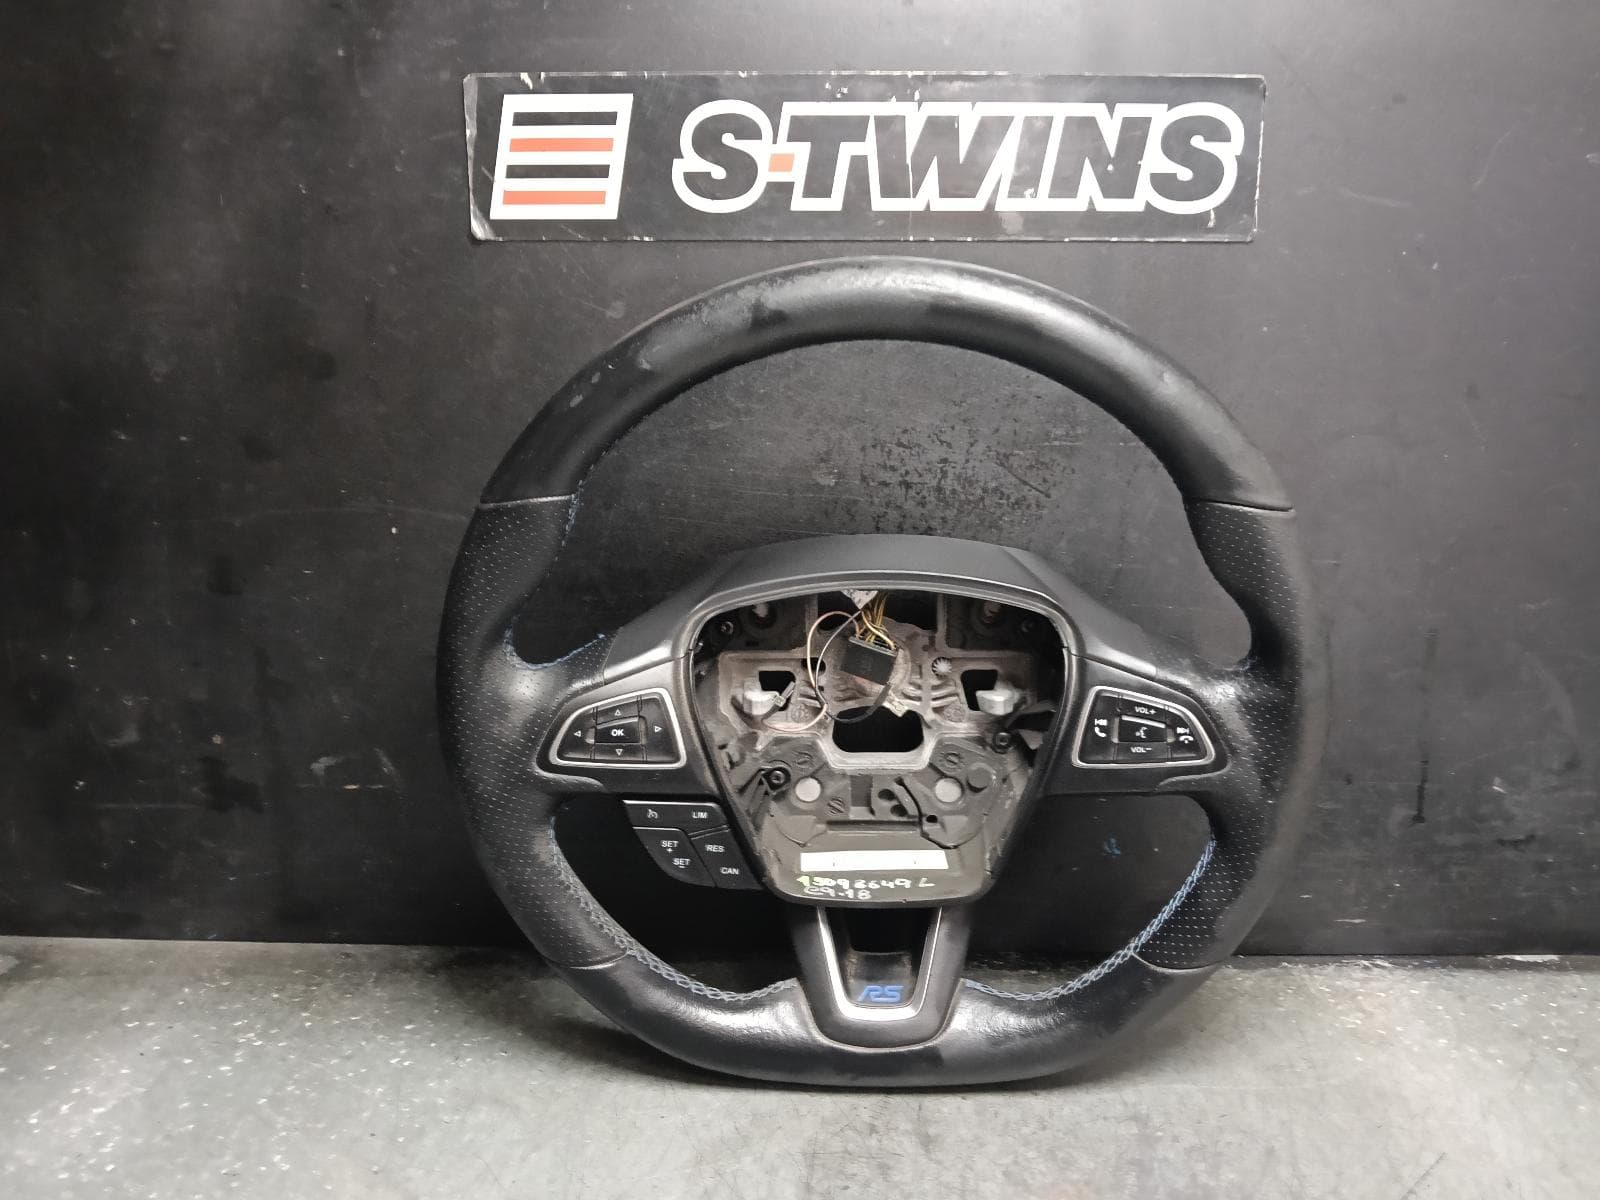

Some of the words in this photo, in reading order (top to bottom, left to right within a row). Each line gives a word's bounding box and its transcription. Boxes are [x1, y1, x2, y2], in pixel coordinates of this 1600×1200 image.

[611, 728, 625, 737] OK
[692, 811, 708, 819] LIM
[661, 840, 679, 848] SET
[705, 844, 725, 853] RES
[672, 858, 690, 866] SET
[720, 867, 740, 875] CAN
[857, 985, 904, 1003] RS
